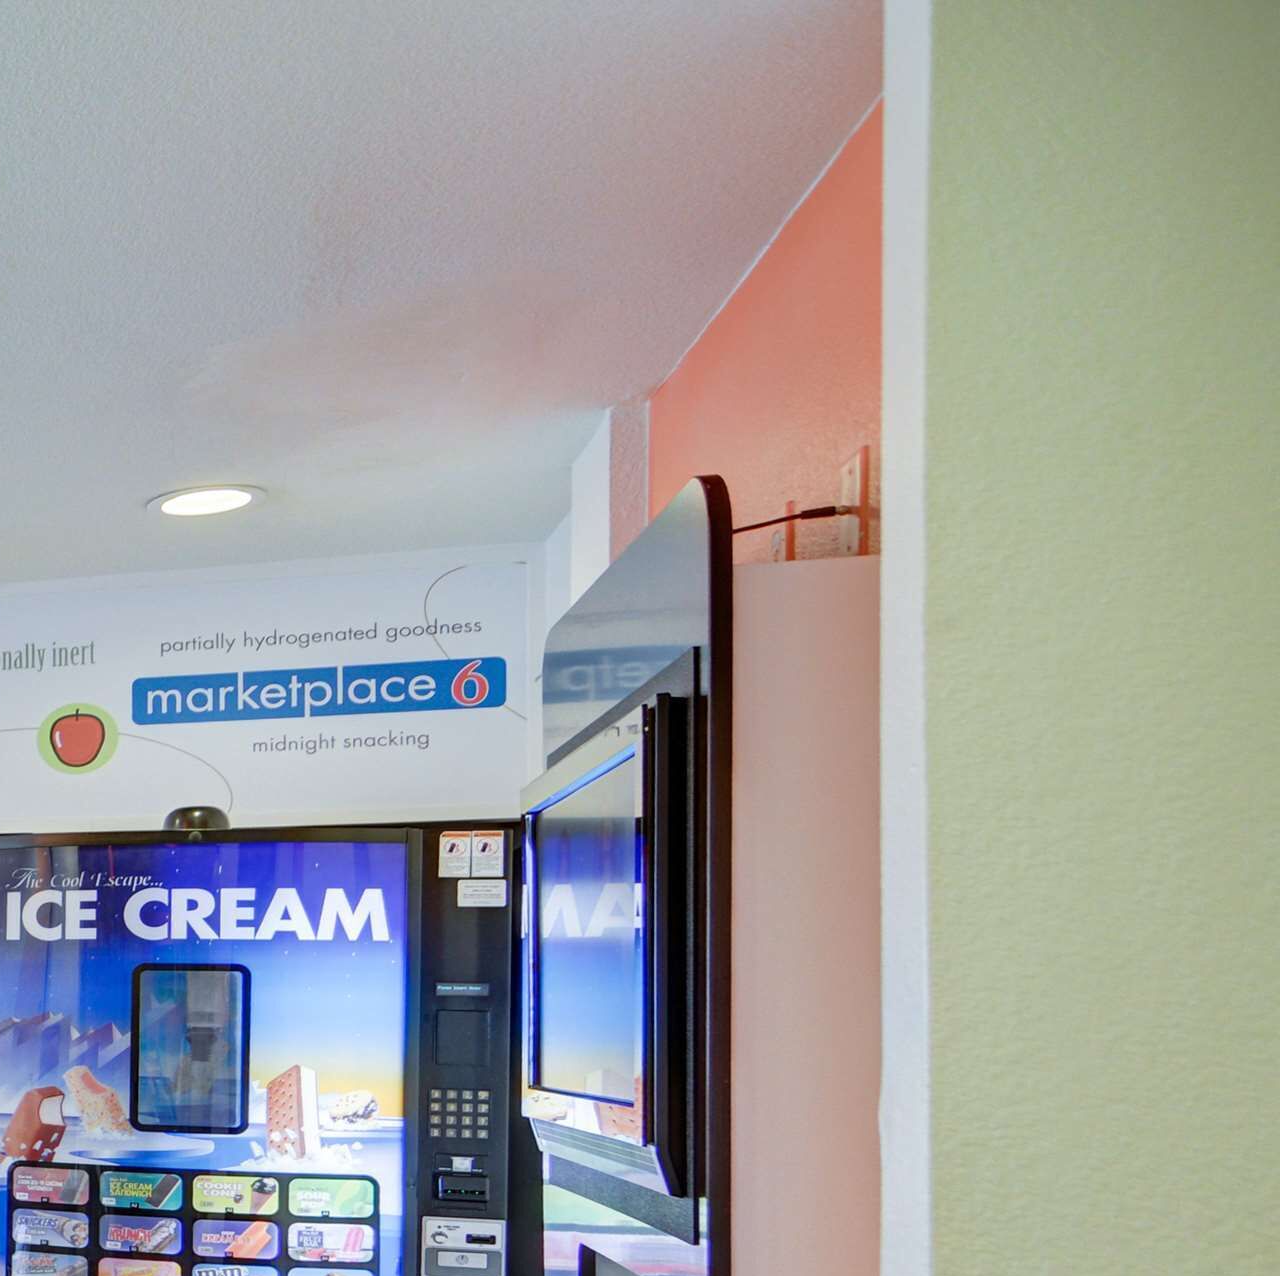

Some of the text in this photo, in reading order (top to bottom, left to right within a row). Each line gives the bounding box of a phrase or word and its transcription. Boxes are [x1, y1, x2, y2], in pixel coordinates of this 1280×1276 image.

[160, 618, 482, 656] partially hydrogenated goodness
[52, 641, 96, 667] inert
[146, 659, 490, 717] marketplace 6
[252, 731, 430, 755] midnight snacking
[5, 868, 42, 889] The
[50, 871, 85, 888] Cool
[6, 887, 390, 942] ICE CREAM
